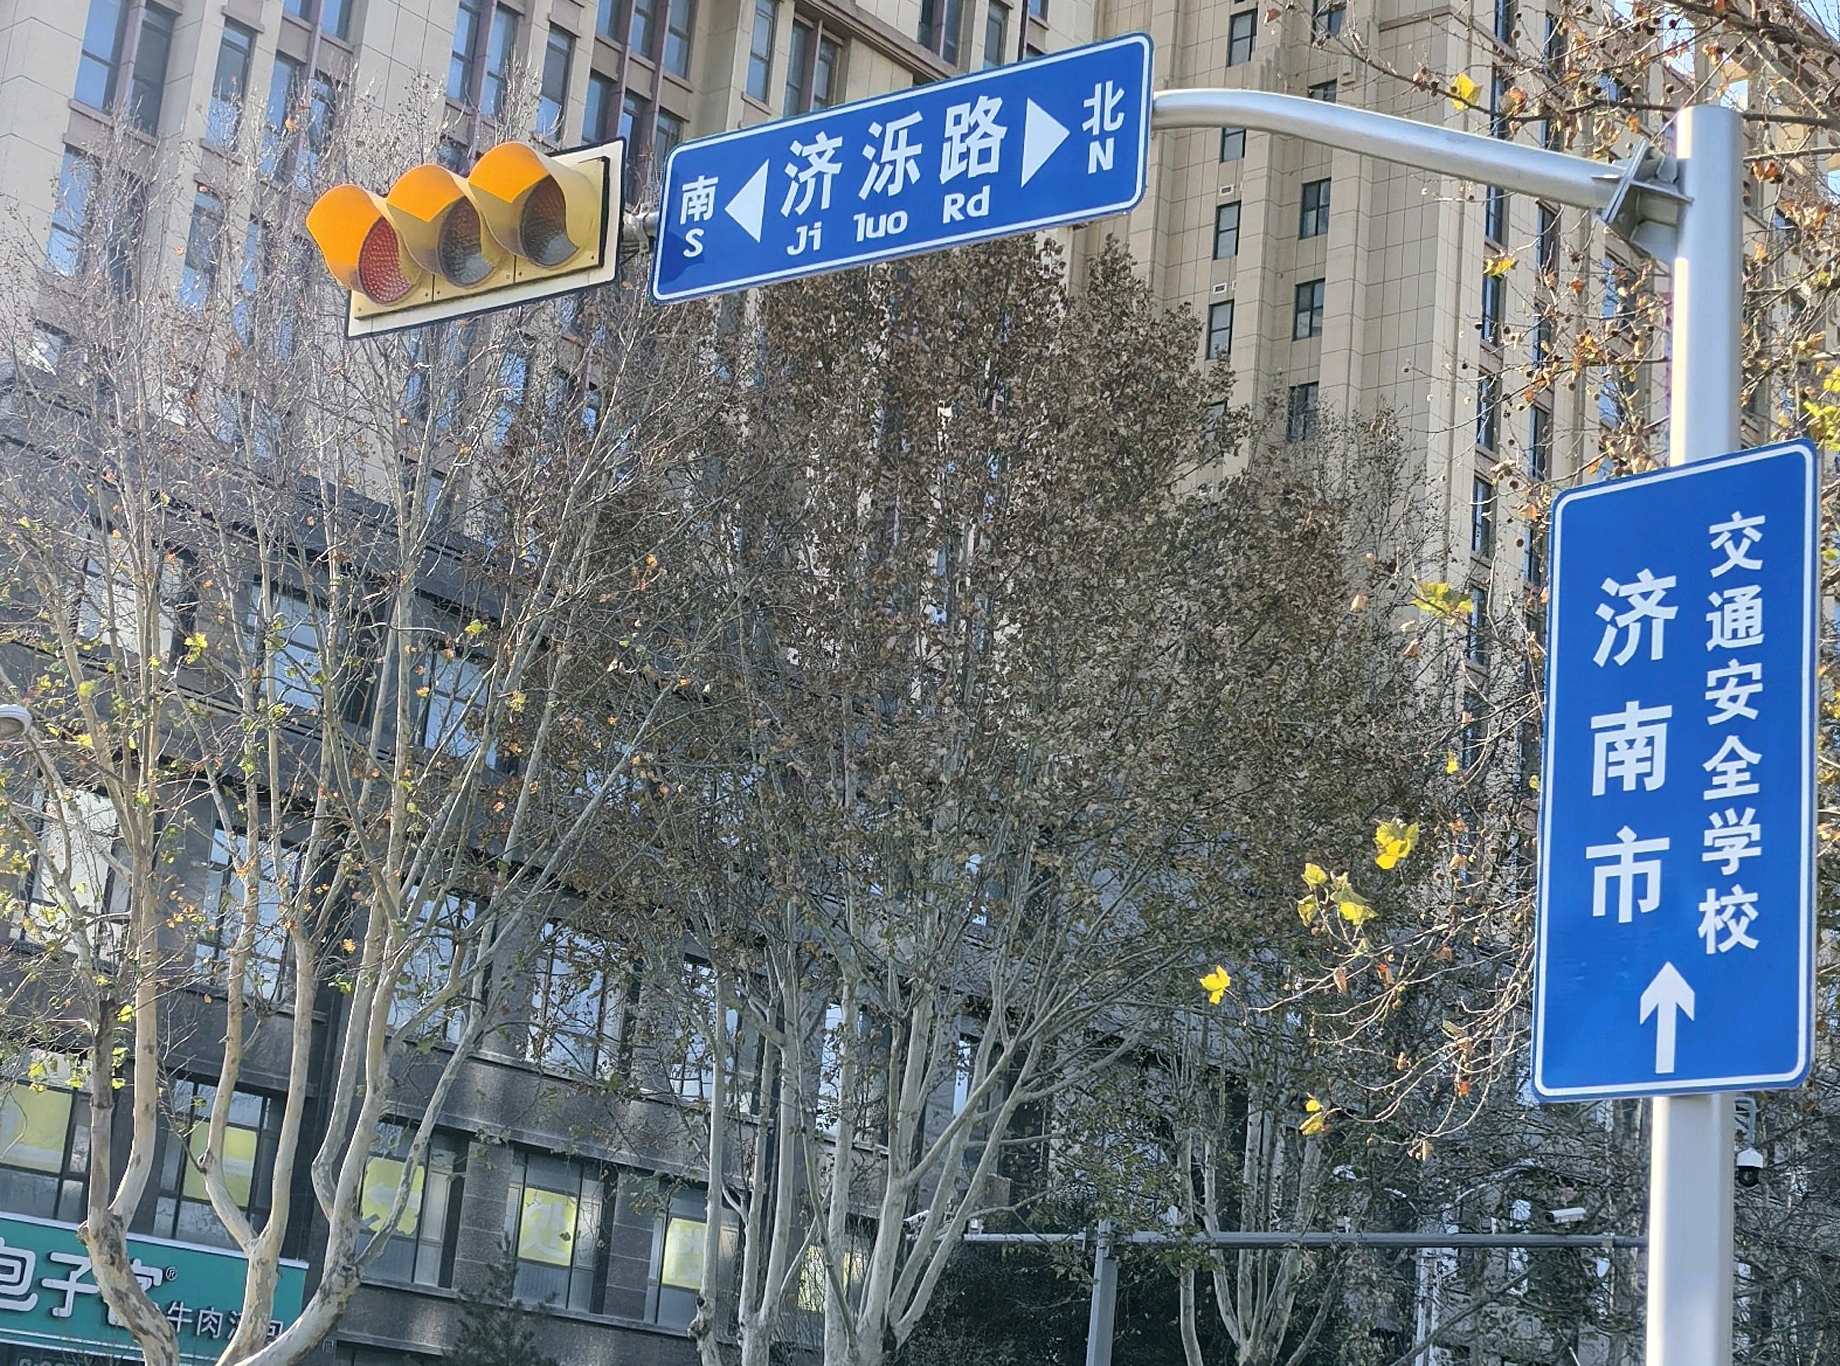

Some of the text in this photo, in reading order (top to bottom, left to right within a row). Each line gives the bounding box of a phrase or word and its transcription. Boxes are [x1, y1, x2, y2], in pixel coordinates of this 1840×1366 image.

[1082, 80, 1125, 137] 北
[780, 95, 1008, 219] 济泺路
[1088, 138, 1114, 175] N
[679, 174, 719, 225] 南
[787, 223, 822, 256] Ji
[942, 185, 990, 224] Rd
[683, 227, 704, 259] S
[1585, 567, 1678, 924] 济南市
[1698, 510, 1766, 955] 交通安全学校
[0, 1238, 164, 1327] 包子
